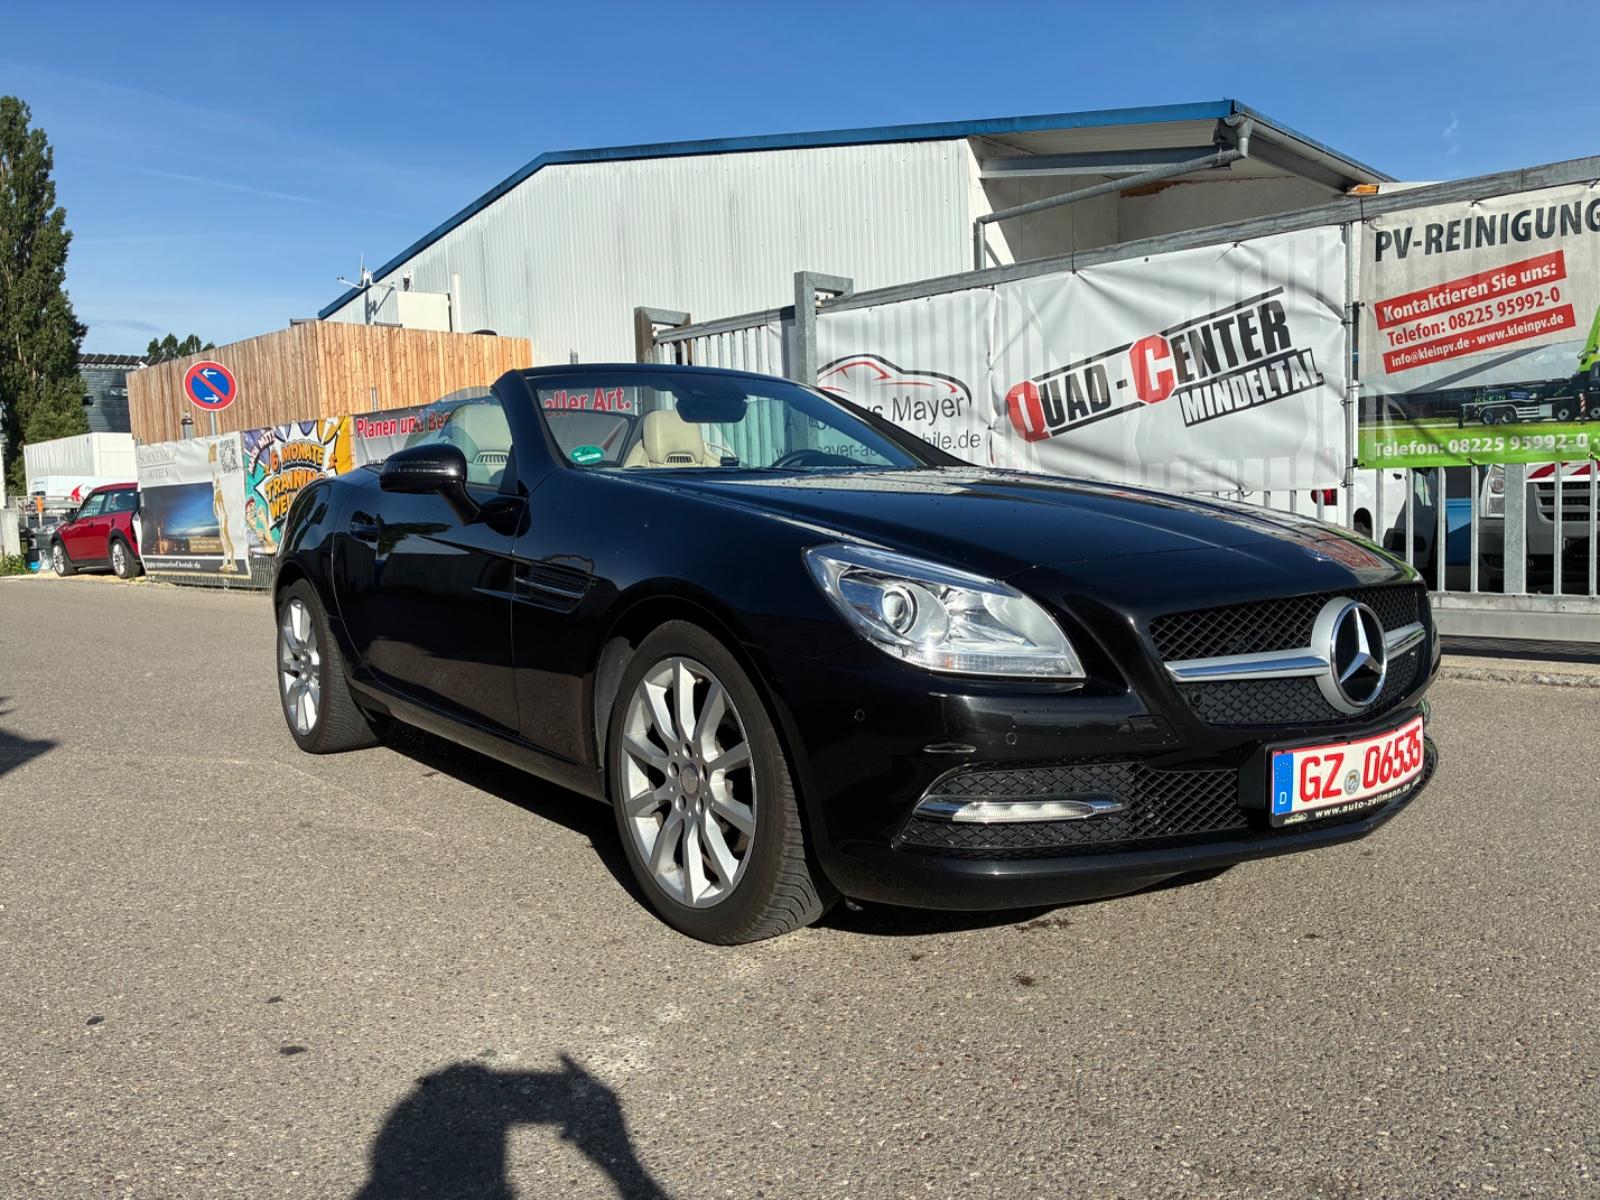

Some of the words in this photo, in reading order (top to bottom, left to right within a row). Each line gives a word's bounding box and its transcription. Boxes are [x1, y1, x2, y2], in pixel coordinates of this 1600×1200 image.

[1383, 282, 1488, 322] Kontaktieren
[1491, 273, 1517, 291] Sie
[1520, 263, 1556, 283] uns:
[1387, 321, 1446, 346] Telefon:
[1448, 305, 1493, 330] 08225
[1496, 286, 1560, 317] 95992-0
[1391, 338, 1470, 367] info@kleinpv.de
[1476, 313, 1564, 345] www.kleinpv.de
[544, 389, 588, 416] aller
[593, 386, 631, 413] Art.
[1179, 348, 1325, 426] MINDELTAL
[356, 417, 397, 439] Planen
[400, 409, 425, 433] und
[892, 396, 965, 426] Mayer
[271, 449, 279, 472] 6
[281, 441, 324, 464] MONATE
[1374, 440, 1444, 457] Telefon:
[1448, 436, 1505, 454] 08225
[1509, 432, 1588, 450] 95992-0
[265, 469, 326, 502] TRAININ
[1300, 752, 1344, 802] GZ
[1363, 725, 1420, 788] 06535
[1279, 791, 1287, 805] D
